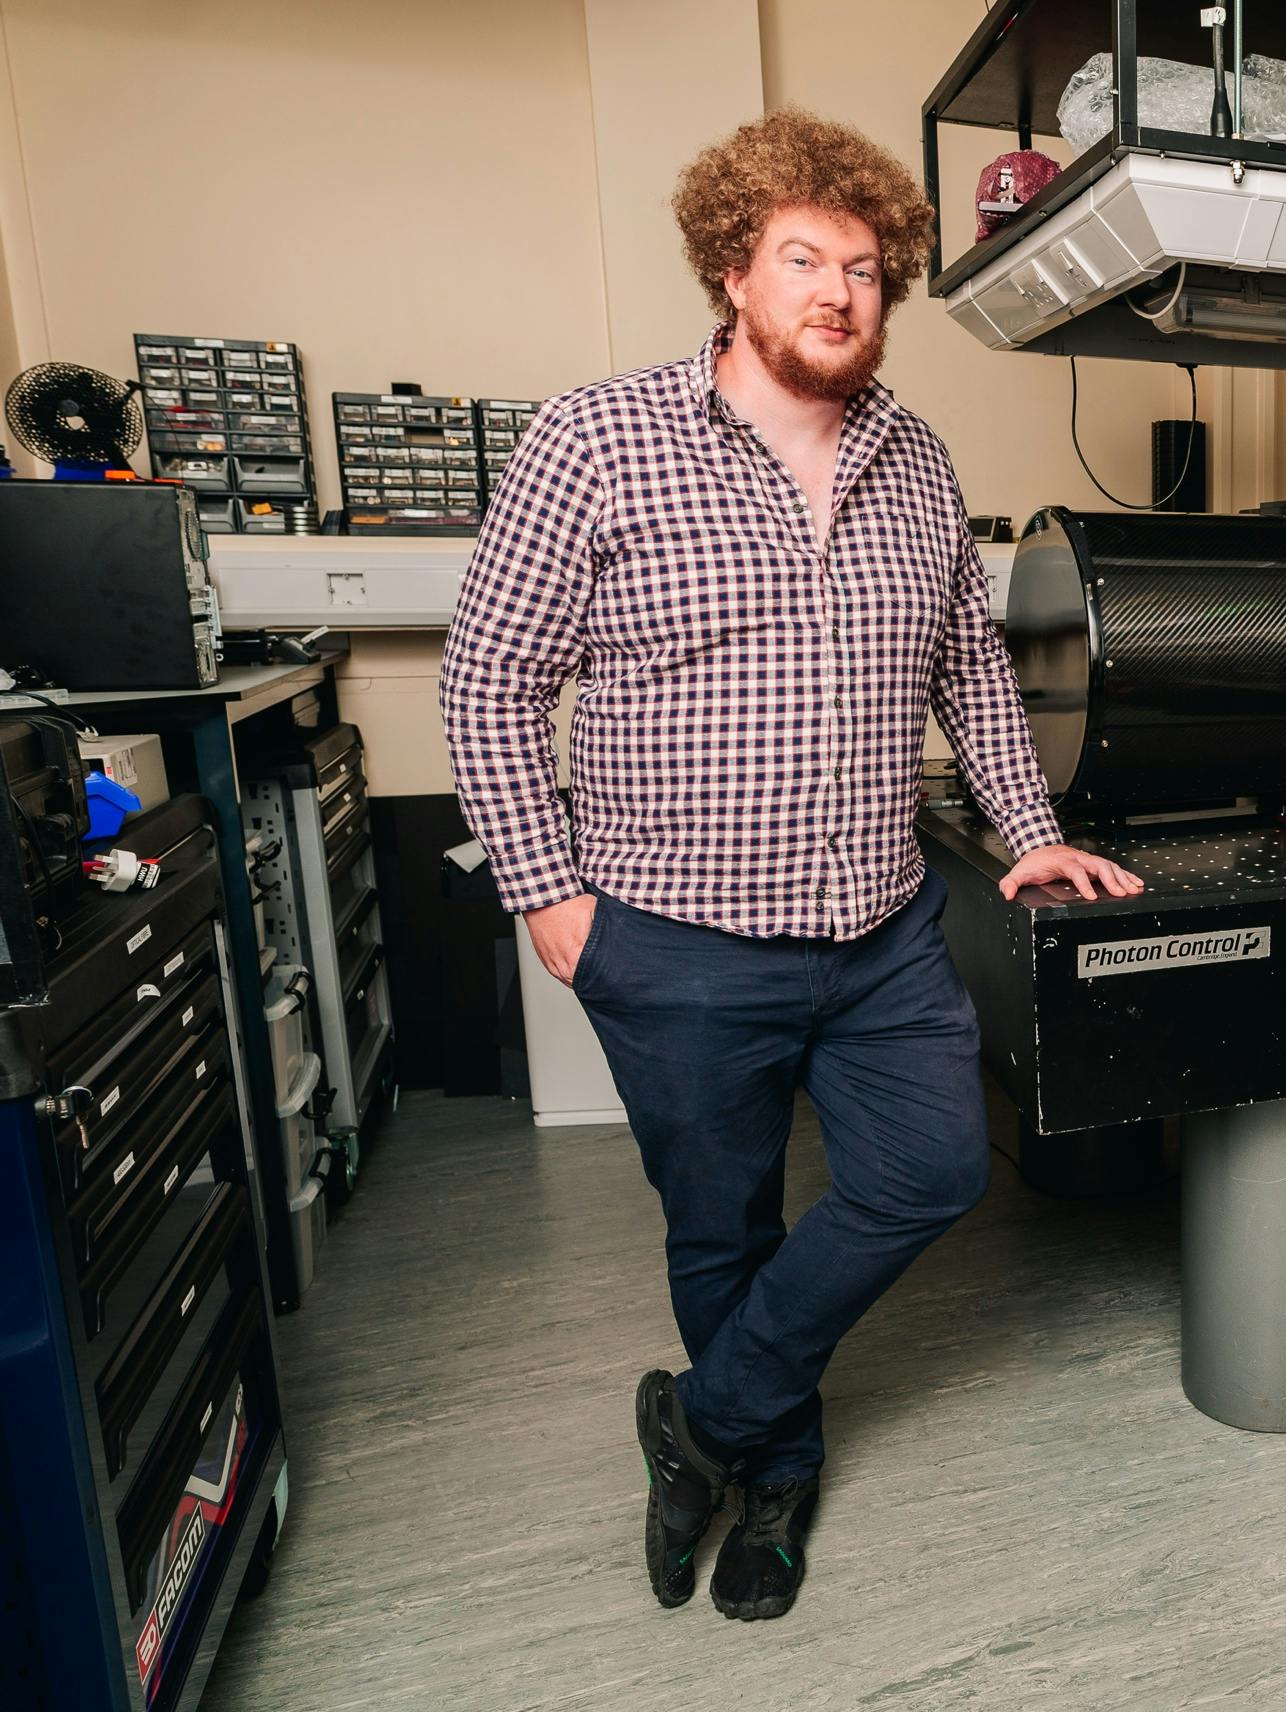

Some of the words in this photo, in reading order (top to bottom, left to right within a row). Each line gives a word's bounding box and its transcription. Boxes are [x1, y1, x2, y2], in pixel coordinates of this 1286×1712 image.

[1085, 944, 1162, 968] Photon
[1166, 933, 1241, 958] Control
[158, 1515, 202, 1629] FACOM
